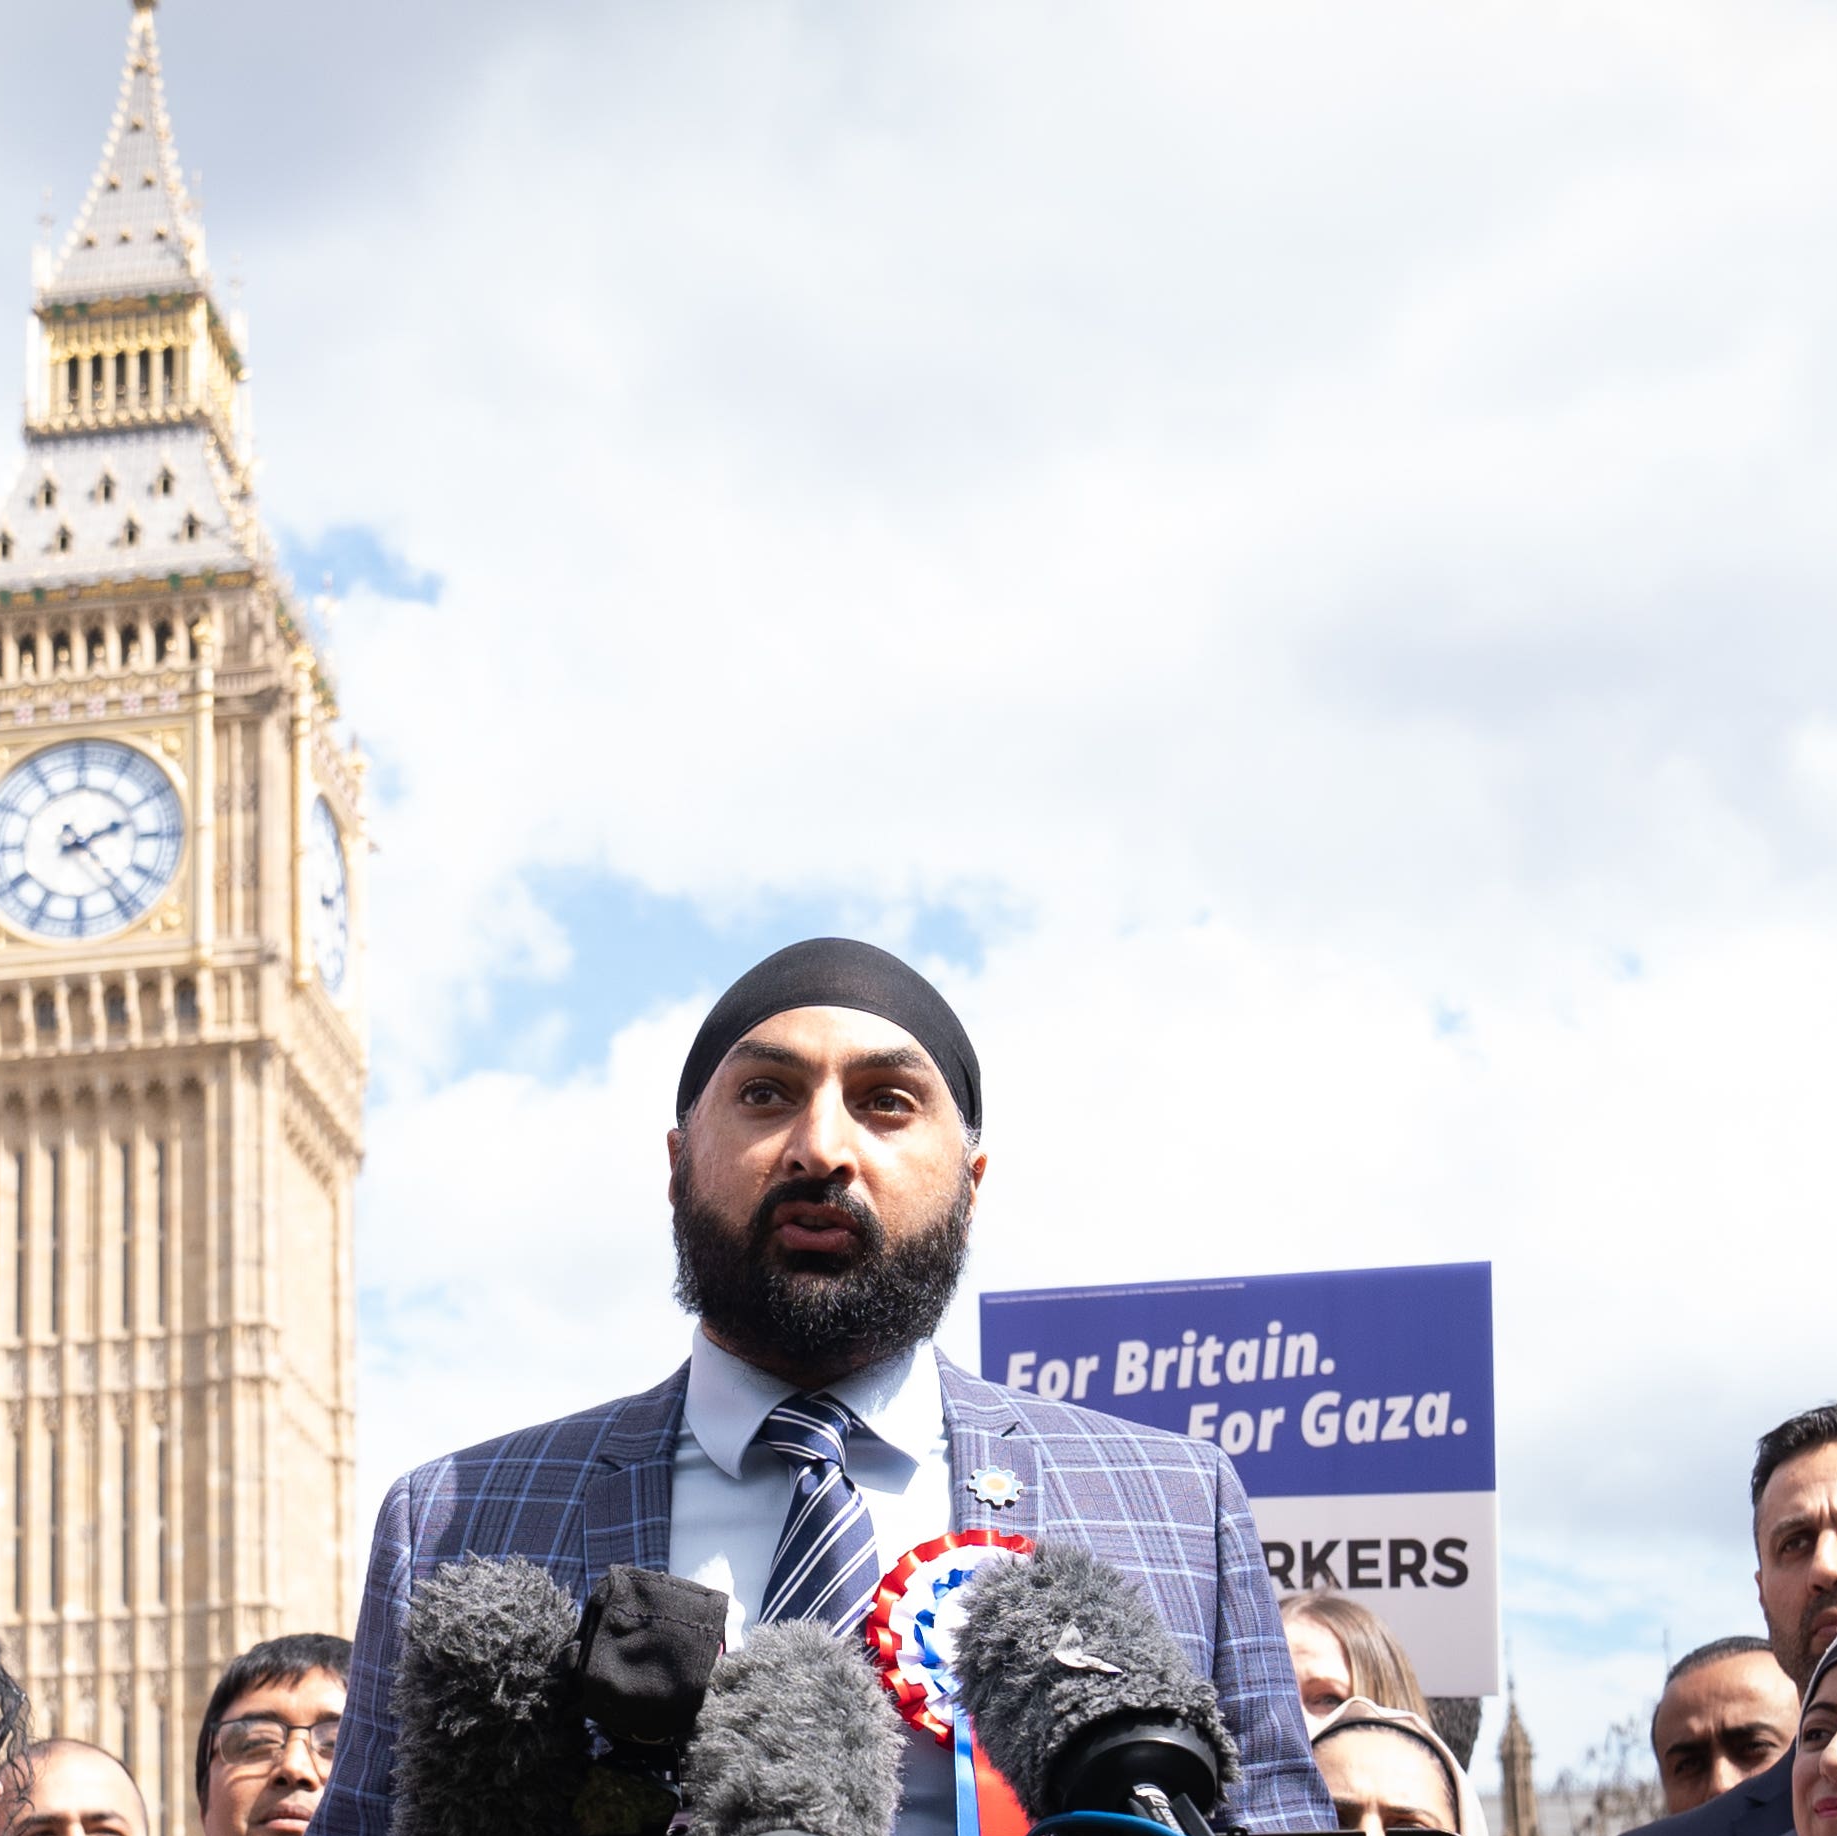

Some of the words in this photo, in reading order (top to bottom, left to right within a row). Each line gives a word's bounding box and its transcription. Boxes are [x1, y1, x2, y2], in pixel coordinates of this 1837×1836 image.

[1005, 1352, 1099, 1401] For
[1113, 1320, 1335, 1396] Britain.
[1188, 1403, 1285, 1456] For
[1300, 1390, 1468, 1449] Gaza.
[1261, 1537, 1470, 1591] RKERS
